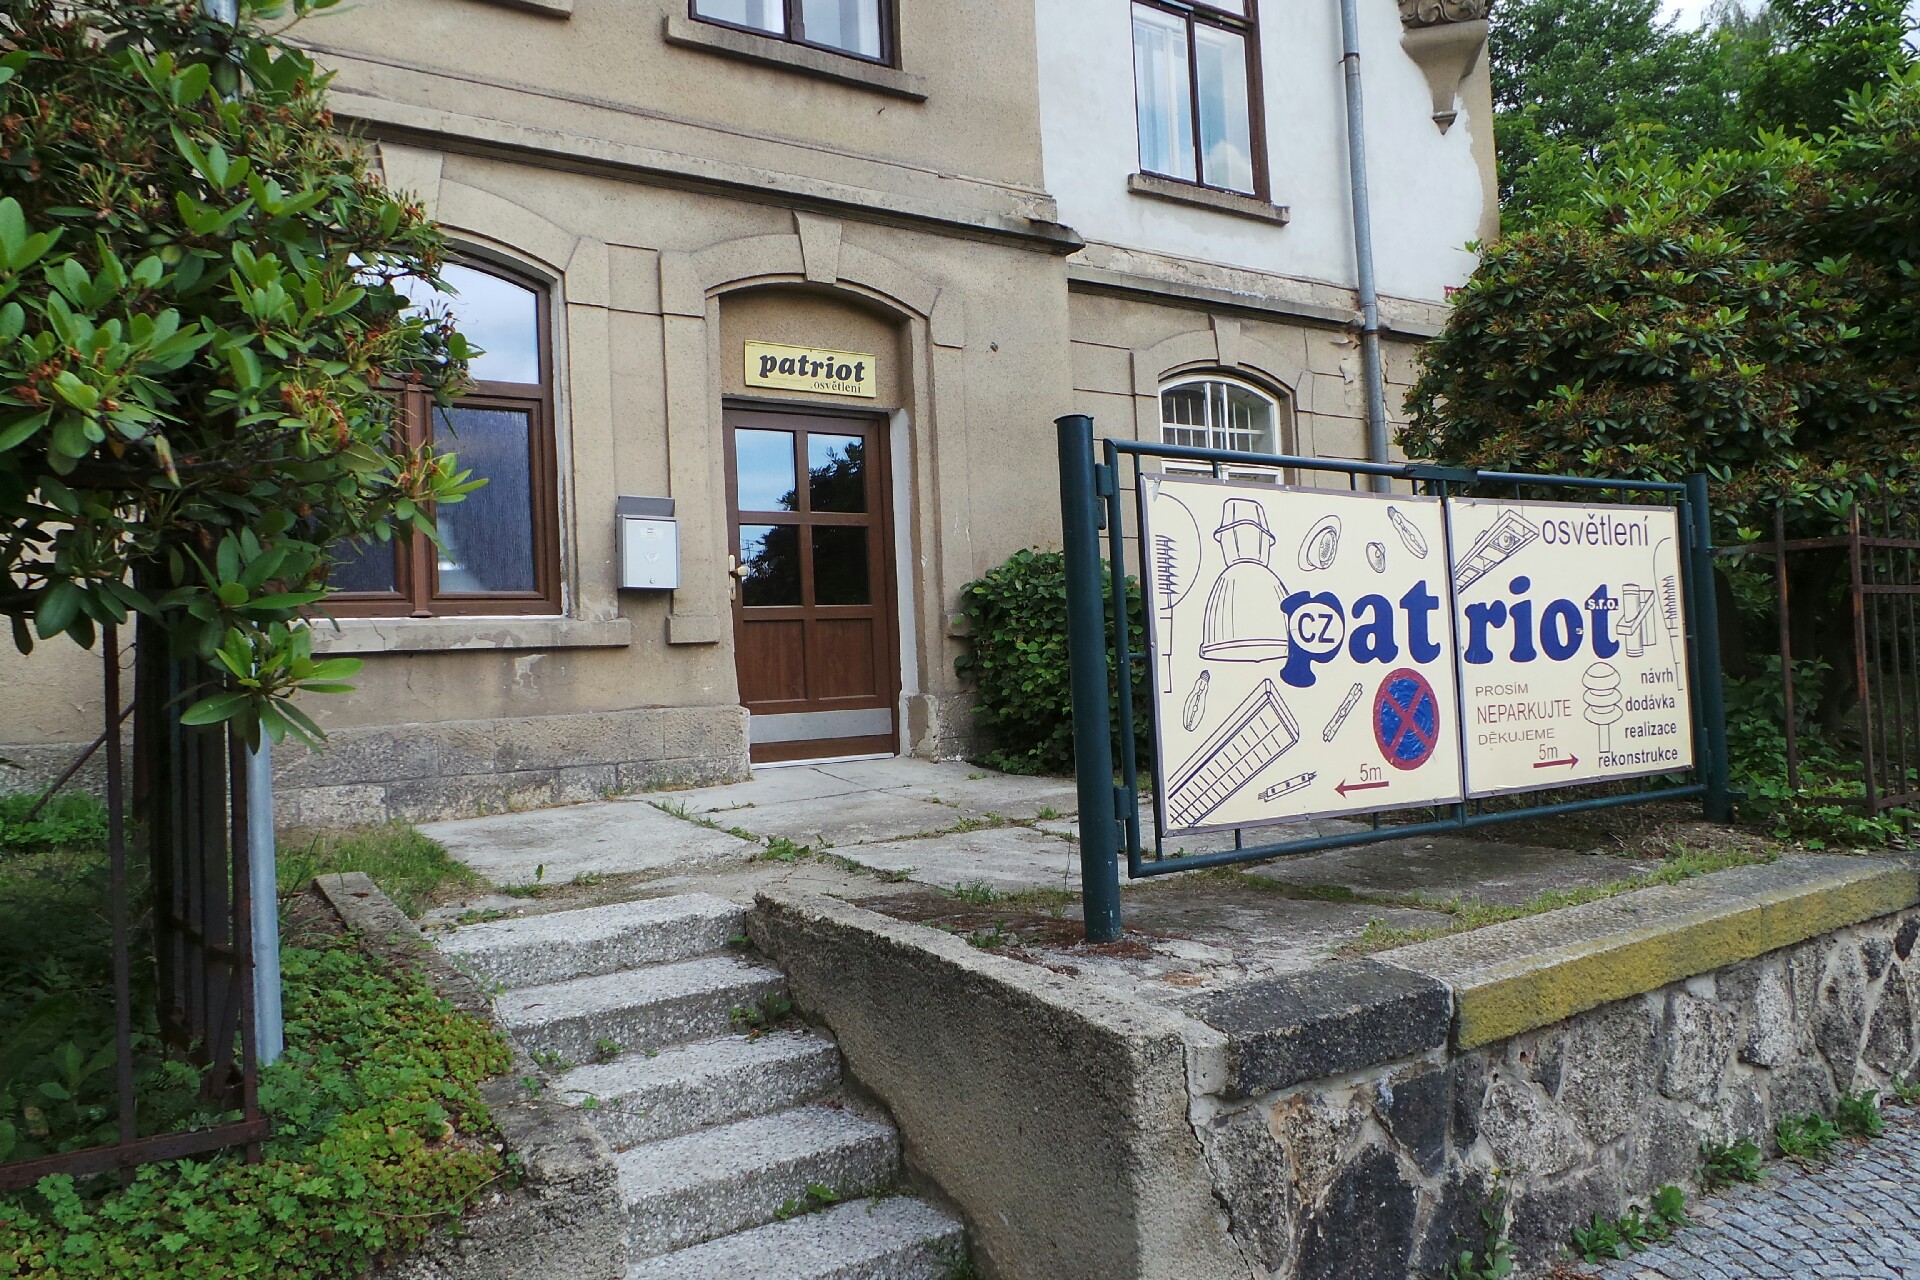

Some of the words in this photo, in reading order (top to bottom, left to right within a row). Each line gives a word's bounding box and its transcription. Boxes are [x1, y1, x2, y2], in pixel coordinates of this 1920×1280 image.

[759, 354, 865, 382] patriot
[1542, 514, 1649, 546] osvětlení
[1587, 598, 1619, 611] s.r.o.
[1280, 576, 1620, 688] patriot
[1297, 612, 1335, 643] CZ
[1640, 667, 1674, 685] návrh
[1475, 682, 1529, 697] PROSÍM
[1477, 699, 1573, 724] NEPARKUJTE
[1625, 695, 1676, 712] dodávka
[1478, 727, 1556, 746] DĚKUJEME
[1624, 721, 1678, 739] realizace
[1538, 743, 1559, 760] 5m
[1598, 746, 1679, 769] rekonstrukce
[1359, 763, 1382, 782] 5m
